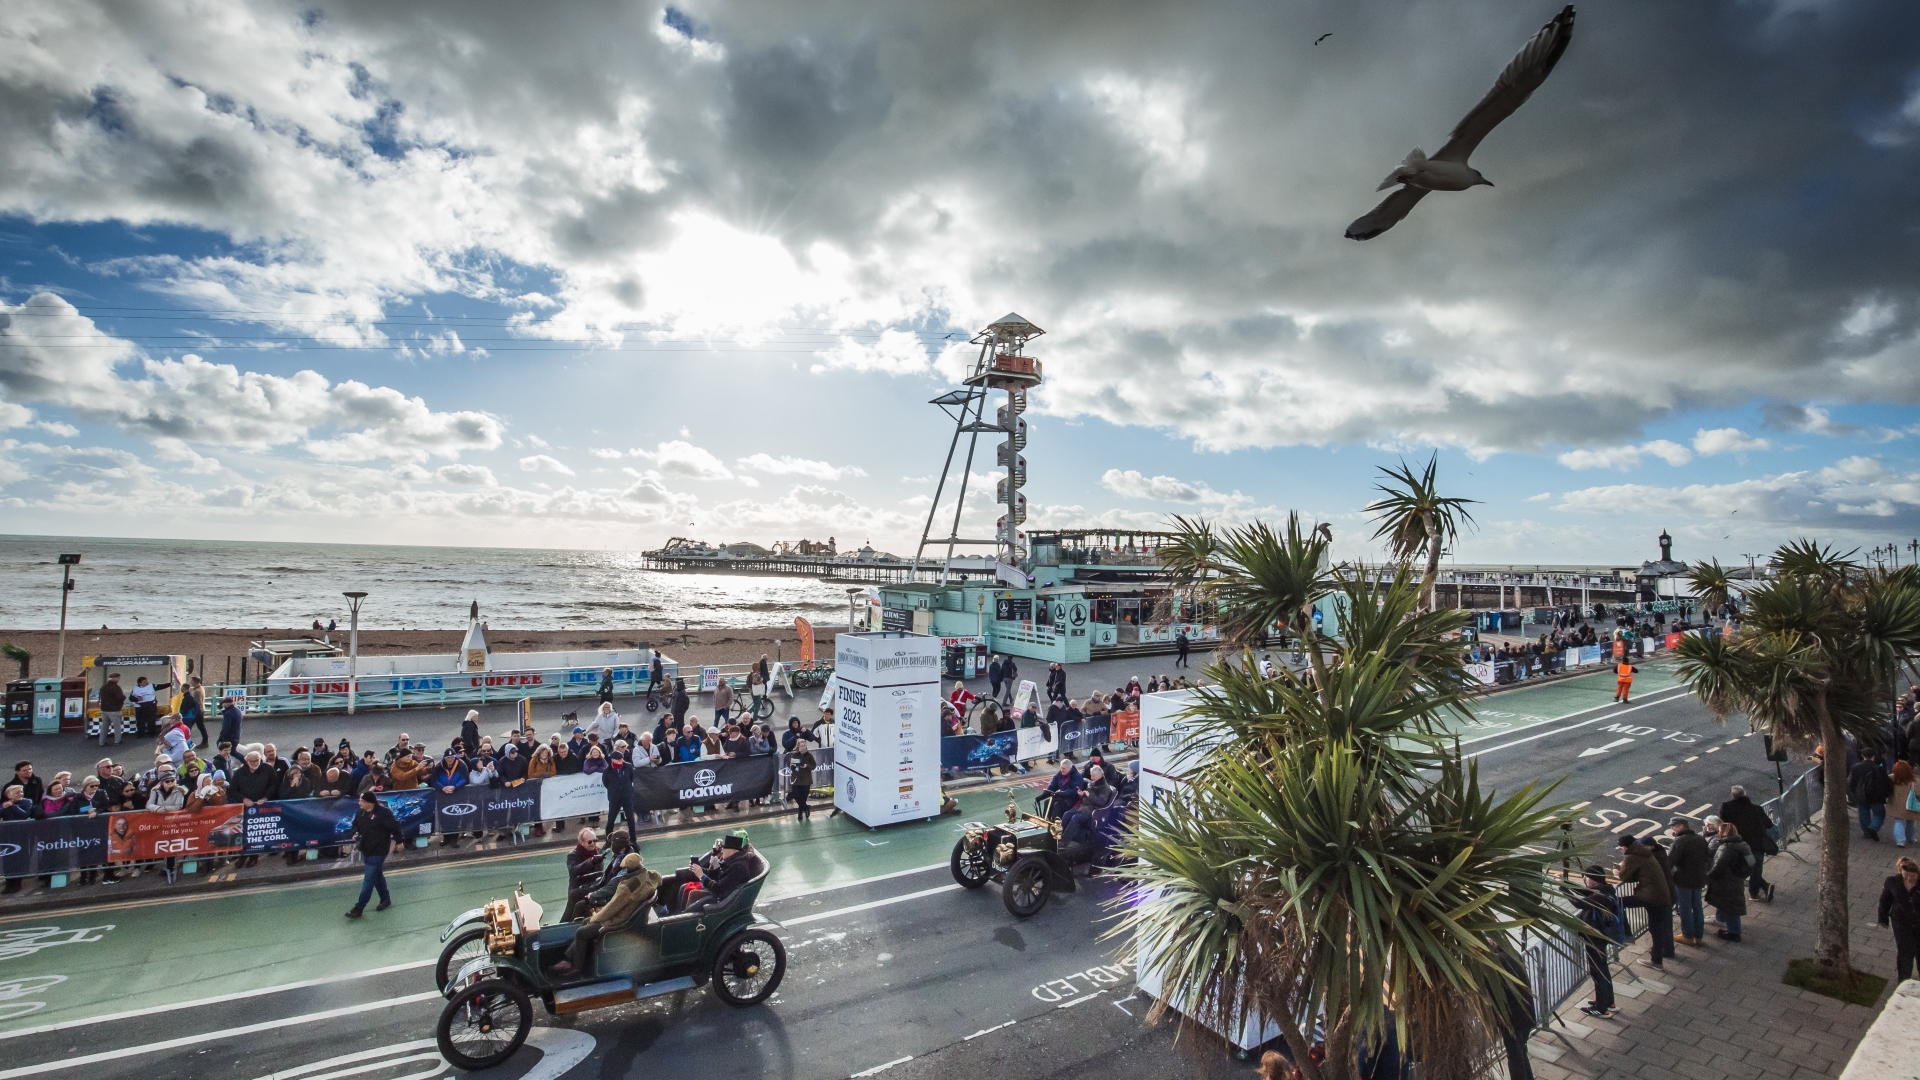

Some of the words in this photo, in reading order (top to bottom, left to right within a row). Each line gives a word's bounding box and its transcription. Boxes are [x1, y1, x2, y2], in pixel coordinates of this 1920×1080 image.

[467, 659, 485, 667] Coffee
[876, 657, 900, 671] LONDON
[901, 656, 909, 666] TO
[909, 655, 938, 666] BRIGHTON
[389, 676, 444, 691] TEAS
[471, 672, 543, 688] COFFEE
[838, 685, 867, 708] FINISH
[843, 706, 861, 726] 2023
[1085, 725, 1107, 735] Sotheby's
[1125, 726, 1140, 737] RAC
[1146, 725, 1180, 748] LONDON
[812, 761, 835, 772] otheb
[679, 784, 732, 800] LOCKTON
[487, 797, 535, 811] Sotheby's
[180, 820, 199, 828] we're
[247, 815, 282, 825] CORDED
[181, 827, 194, 835] you
[247, 822, 278, 831] POWER
[247, 827, 285, 837] WITHOUT
[37, 836, 101, 852] Sotheby's
[246, 836, 263, 844] THE
[264, 833, 289, 842] CORD.
[155, 836, 200, 855] RAC
